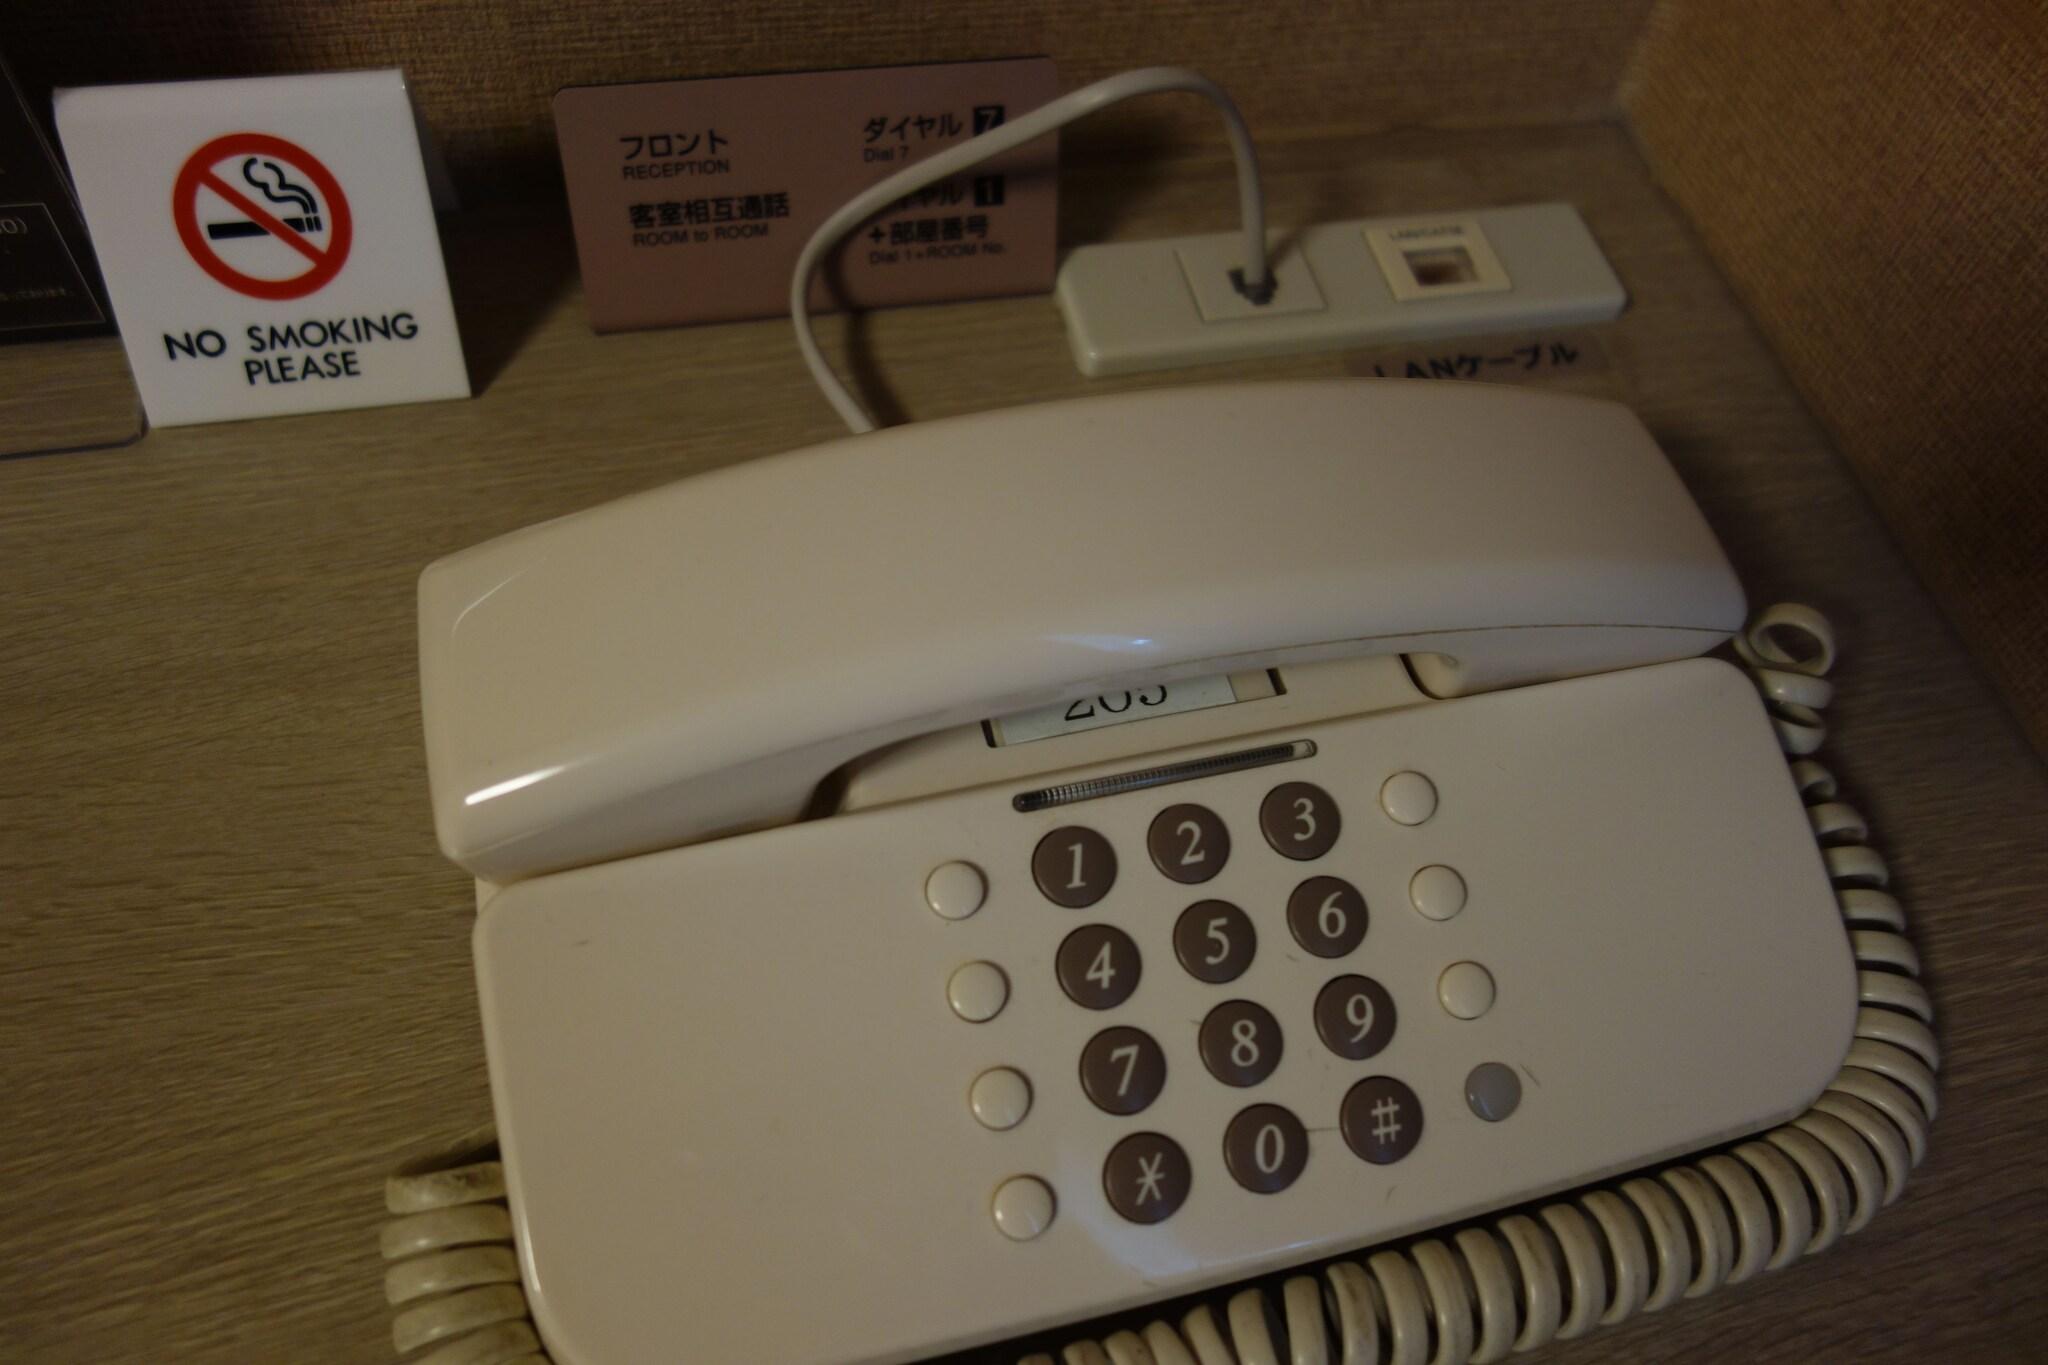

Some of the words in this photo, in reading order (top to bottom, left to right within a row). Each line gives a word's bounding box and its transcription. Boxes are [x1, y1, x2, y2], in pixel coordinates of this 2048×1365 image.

[620, 129, 728, 160] フロント
[863, 114, 963, 142] ダイヤル
[623, 160, 730, 181] RECEPTION
[863, 147, 893, 162] Dial
[899, 146, 909, 159] 7
[629, 192, 790, 228] 客室相互通話
[633, 230, 688, 247] ROOM
[694, 230, 709, 243] to
[715, 224, 768, 240] ROOM
[869, 250, 898, 264] Dial
[163, 329, 227, 360] NO
[247, 313, 419, 352] SMOKING
[244, 351, 361, 385] PLEASE
[1065, 843, 1087, 889] 1
[1176, 821, 1205, 865] 2
[1293, 798, 1316, 841] 3
[1086, 941, 1116, 989] 4
[1205, 917, 1230, 965] 5
[1318, 891, 1347, 938] 6
[1110, 1044, 1139, 1097] 7
[1230, 1019, 1260, 1067] 8
[1346, 993, 1374, 1044] 9
[1255, 1123, 1285, 1174] 0
